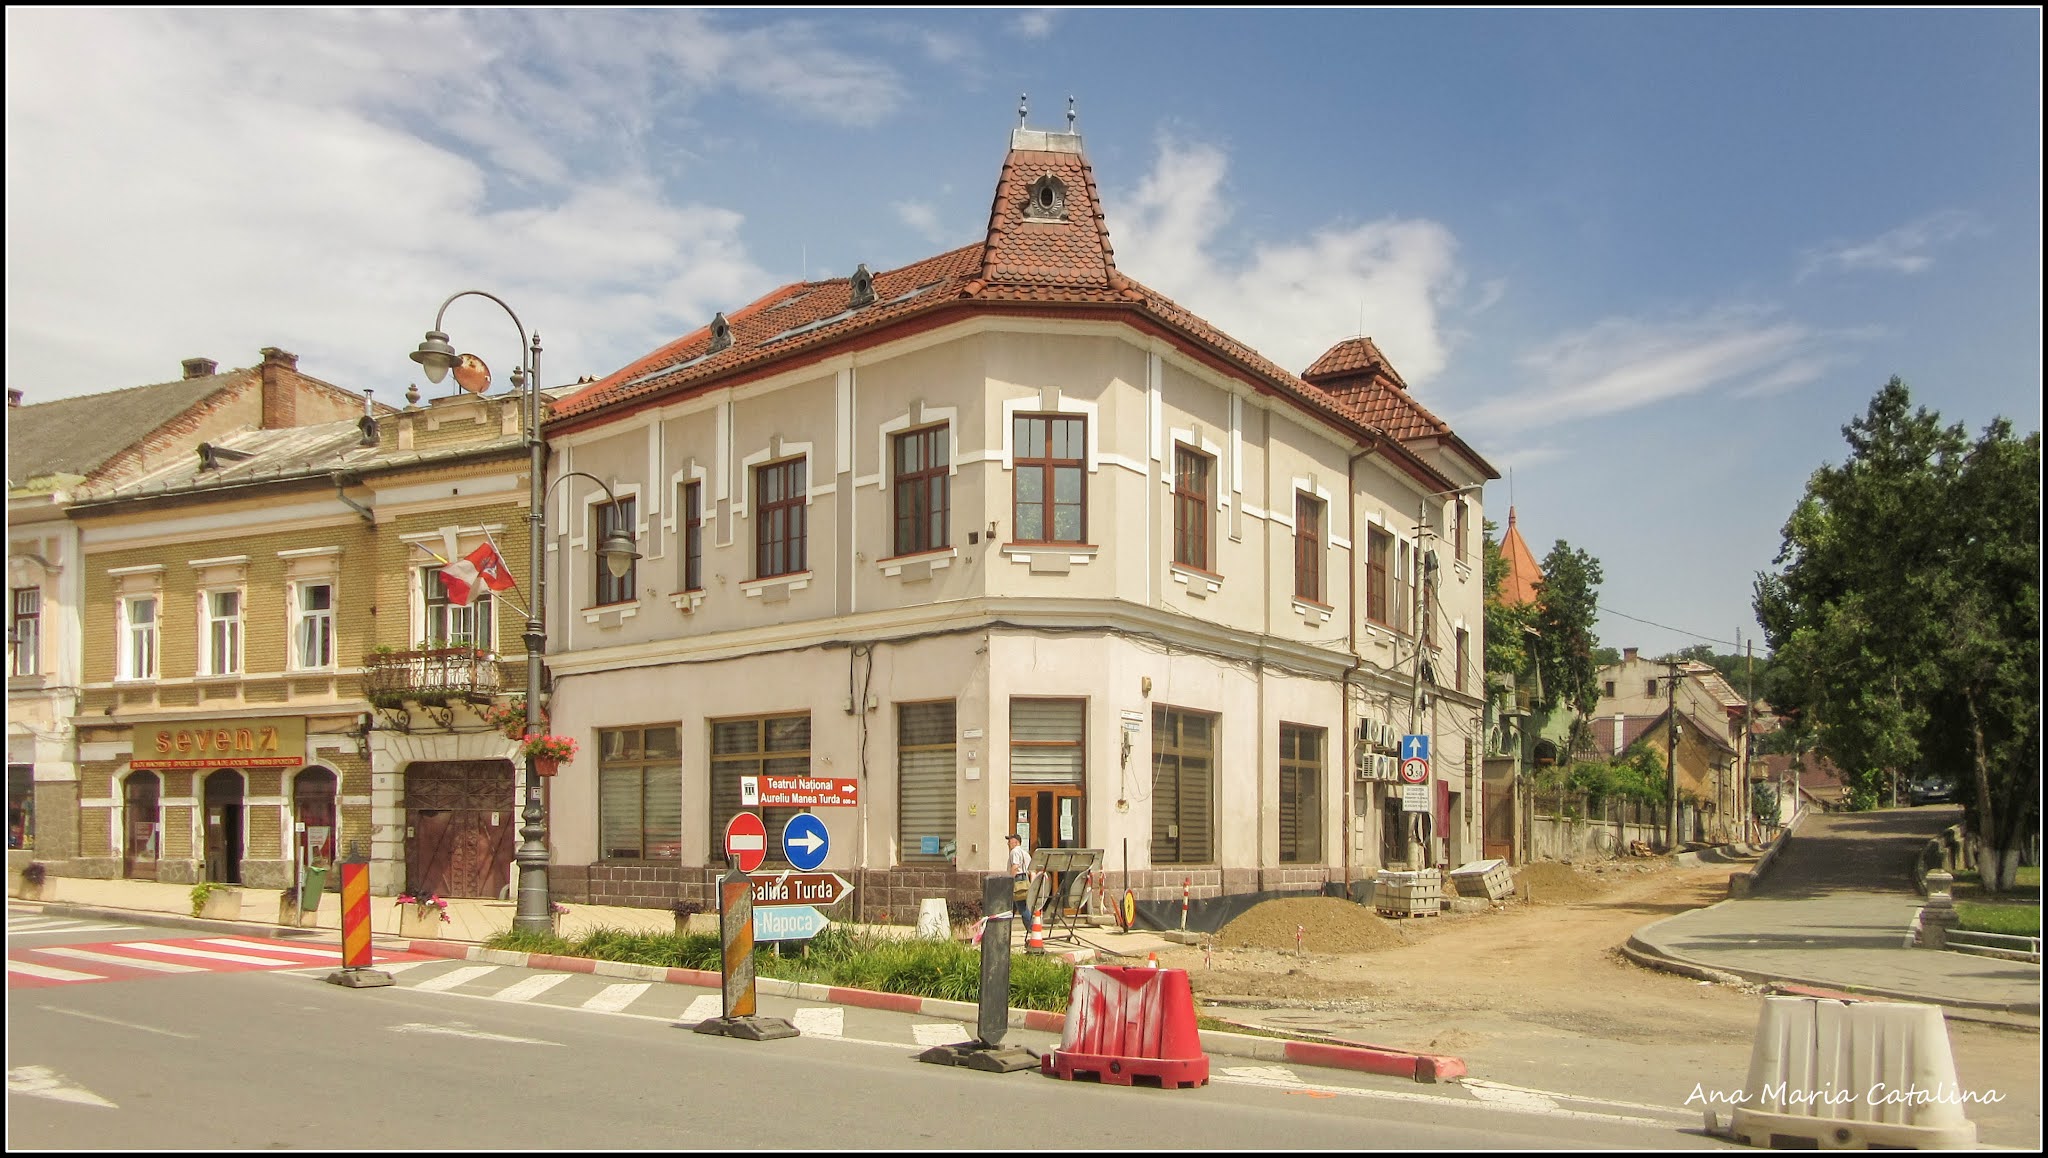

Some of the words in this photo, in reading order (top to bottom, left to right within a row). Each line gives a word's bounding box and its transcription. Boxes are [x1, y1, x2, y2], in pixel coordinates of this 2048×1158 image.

[767, 778, 797, 789] Teatrul
[760, 793, 790, 803] Aureliu
[791, 793, 817, 804] Manea
[818, 794, 840, 804] Turda
[794, 880, 833, 899] Turda
